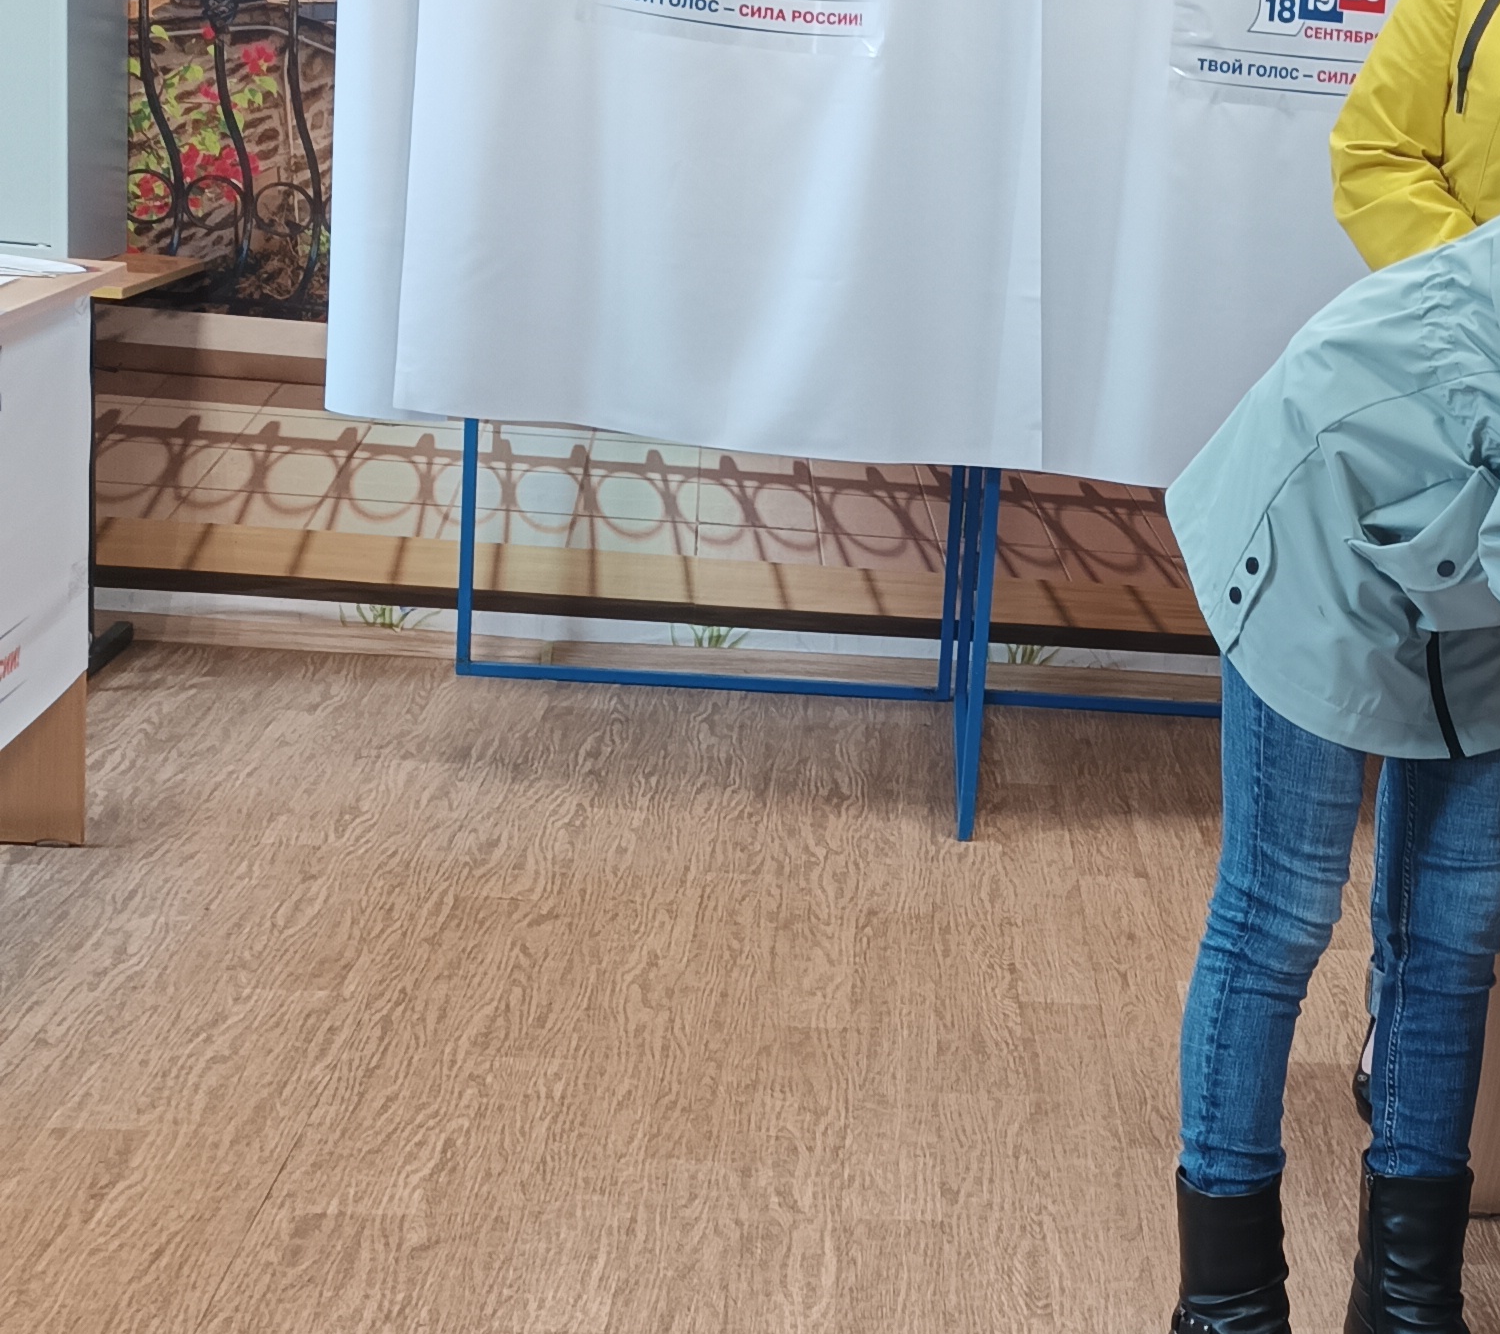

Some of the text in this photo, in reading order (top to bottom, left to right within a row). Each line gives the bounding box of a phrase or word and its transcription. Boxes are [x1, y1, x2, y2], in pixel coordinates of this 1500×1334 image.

[739, 4, 786, 22] СИЛА
[791, 10, 863, 27] РОССИИ!
[1197, 58, 1242, 75] ТВОЙ
[1247, 63, 1299, 80] ГОЛОС
